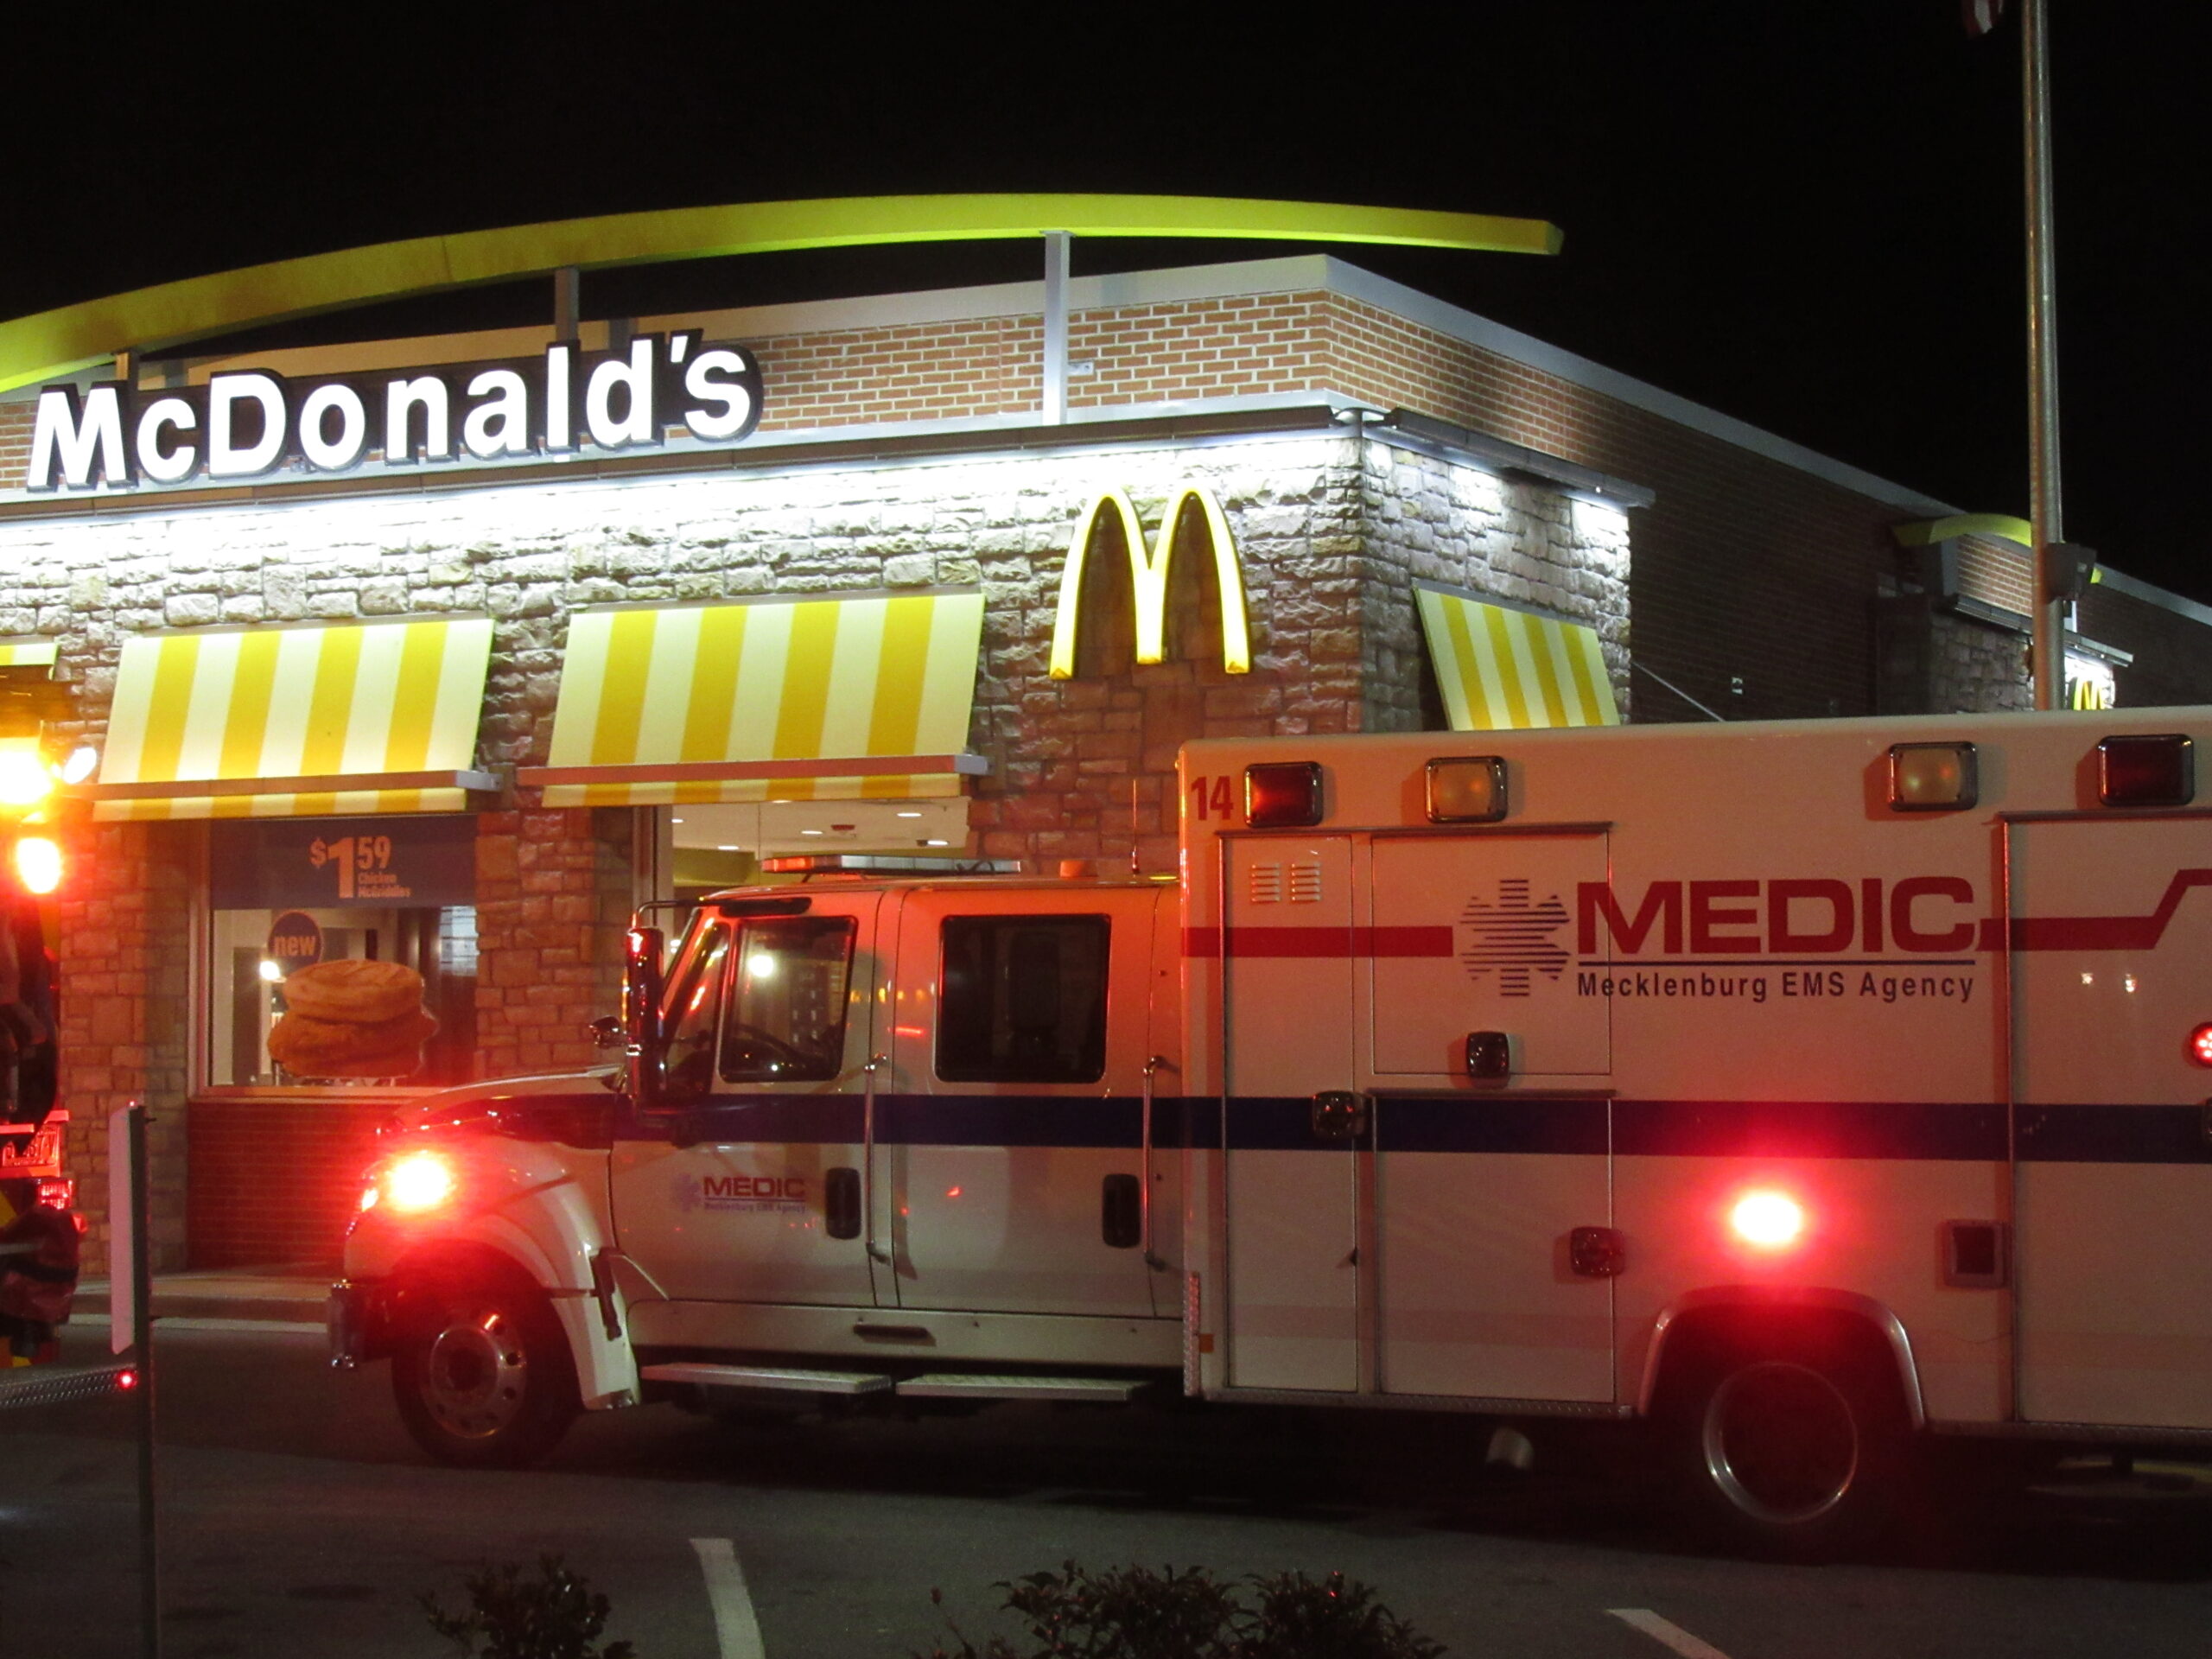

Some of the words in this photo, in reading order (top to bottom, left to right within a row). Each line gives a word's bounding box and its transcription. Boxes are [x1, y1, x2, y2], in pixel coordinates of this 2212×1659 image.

[27, 330, 760, 490] McDonald's
[1192, 775, 1234, 821] 14
[1577, 876, 1975, 955] MEDIC
[274, 935, 316, 957] new
[1577, 971, 1767, 1002] Mecklenburg
[1782, 970, 1846, 997] EMS
[1859, 970, 1974, 1003] Agency
[703, 1176, 806, 1198] MEDIC
